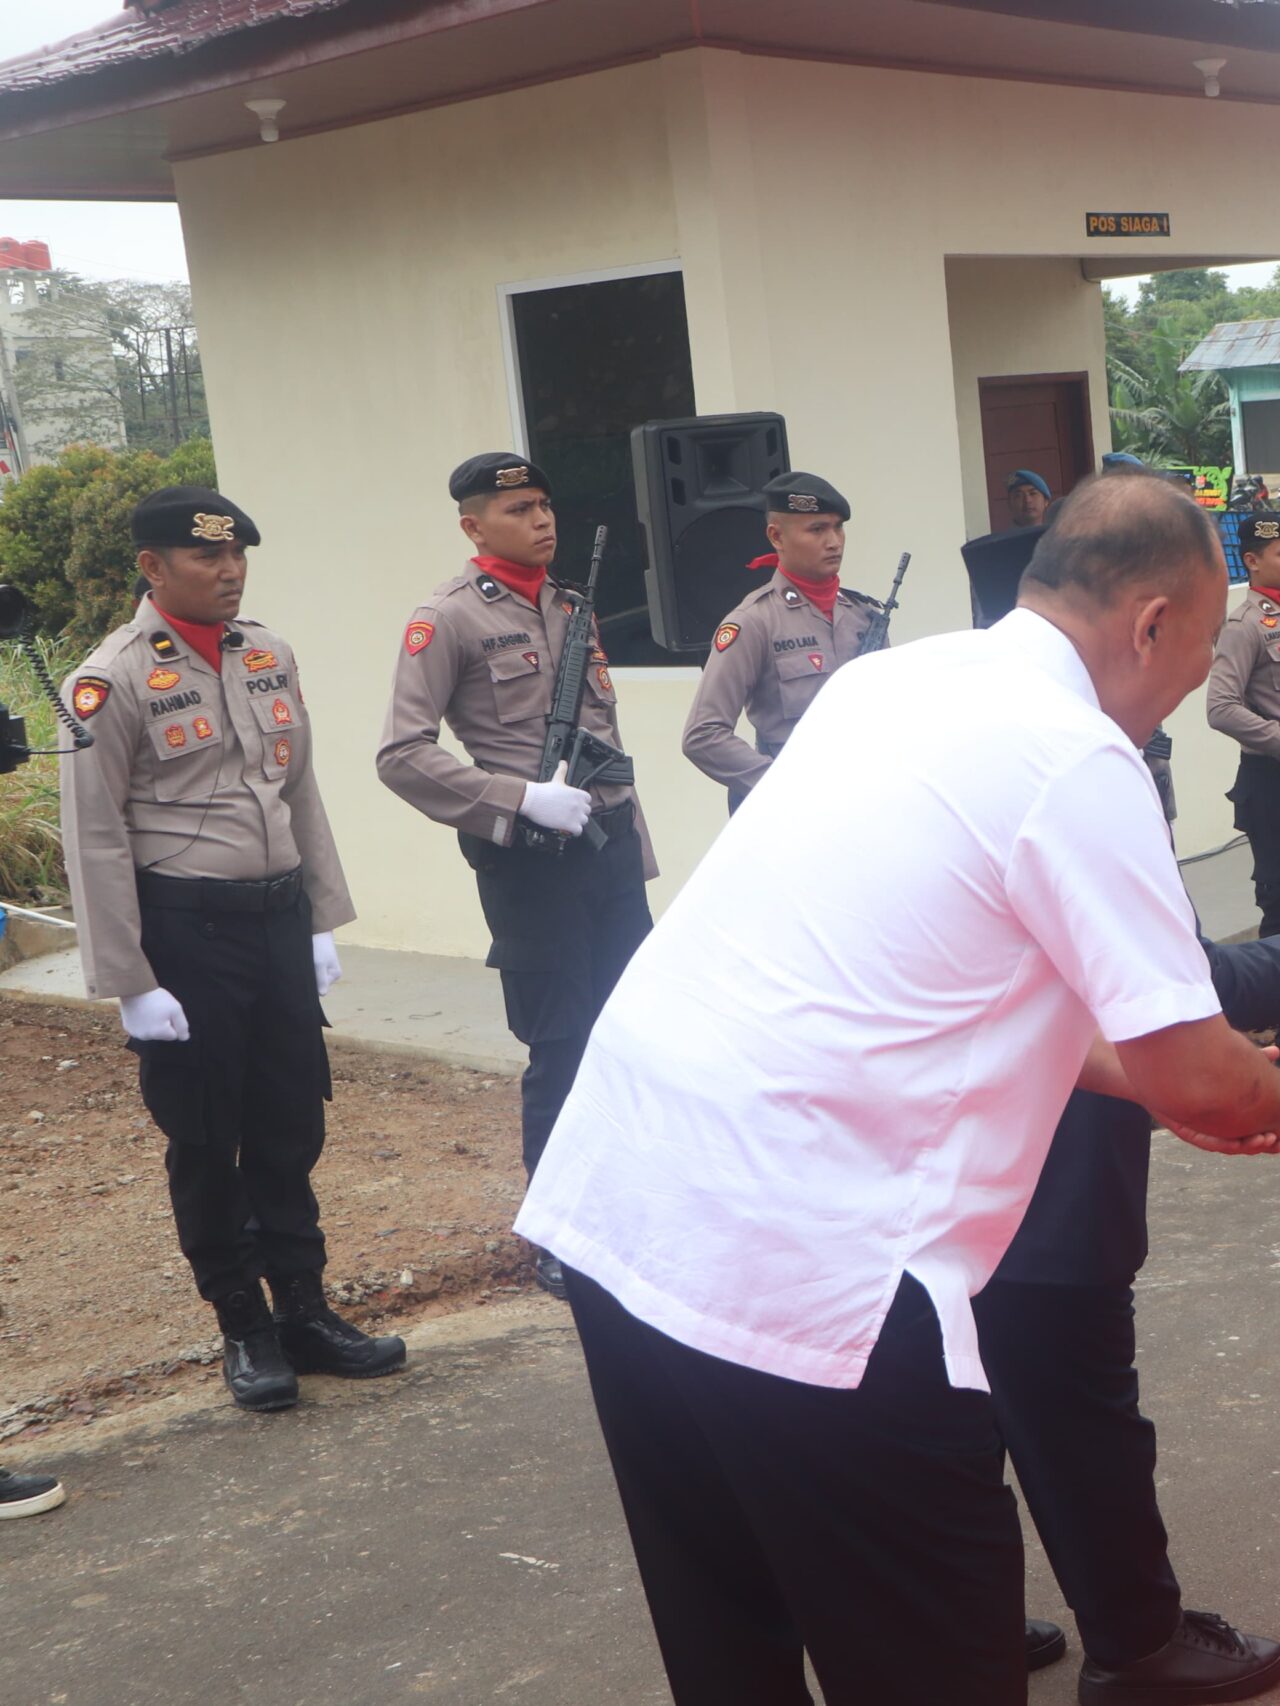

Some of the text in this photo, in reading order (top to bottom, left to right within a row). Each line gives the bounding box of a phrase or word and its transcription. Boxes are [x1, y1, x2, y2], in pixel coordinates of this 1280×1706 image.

[1089, 216, 1116, 232] POS
[1120, 216, 1160, 232] SIAGA
[773, 635, 818, 653] DEO LAIA
[150, 690, 201, 717] RAHMAD
